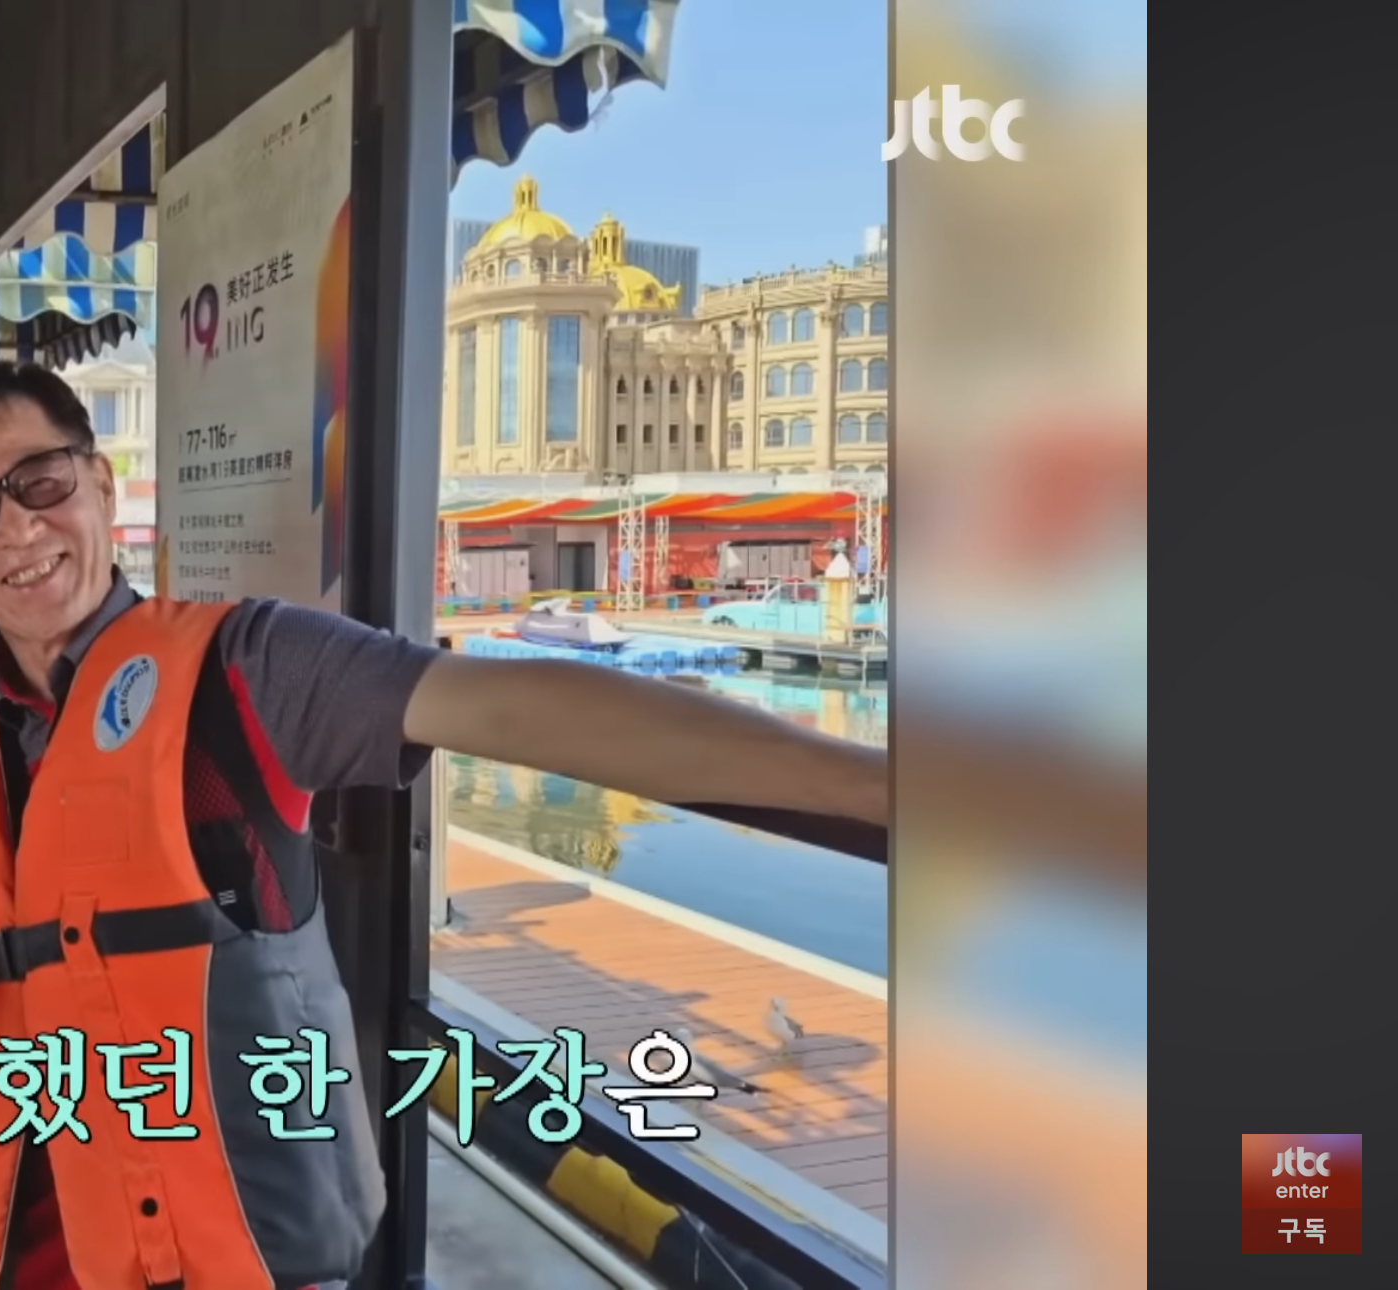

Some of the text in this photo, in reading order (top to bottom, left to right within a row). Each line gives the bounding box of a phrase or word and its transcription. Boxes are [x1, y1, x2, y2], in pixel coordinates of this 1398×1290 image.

[227, 250, 294, 307] 美好正发生
